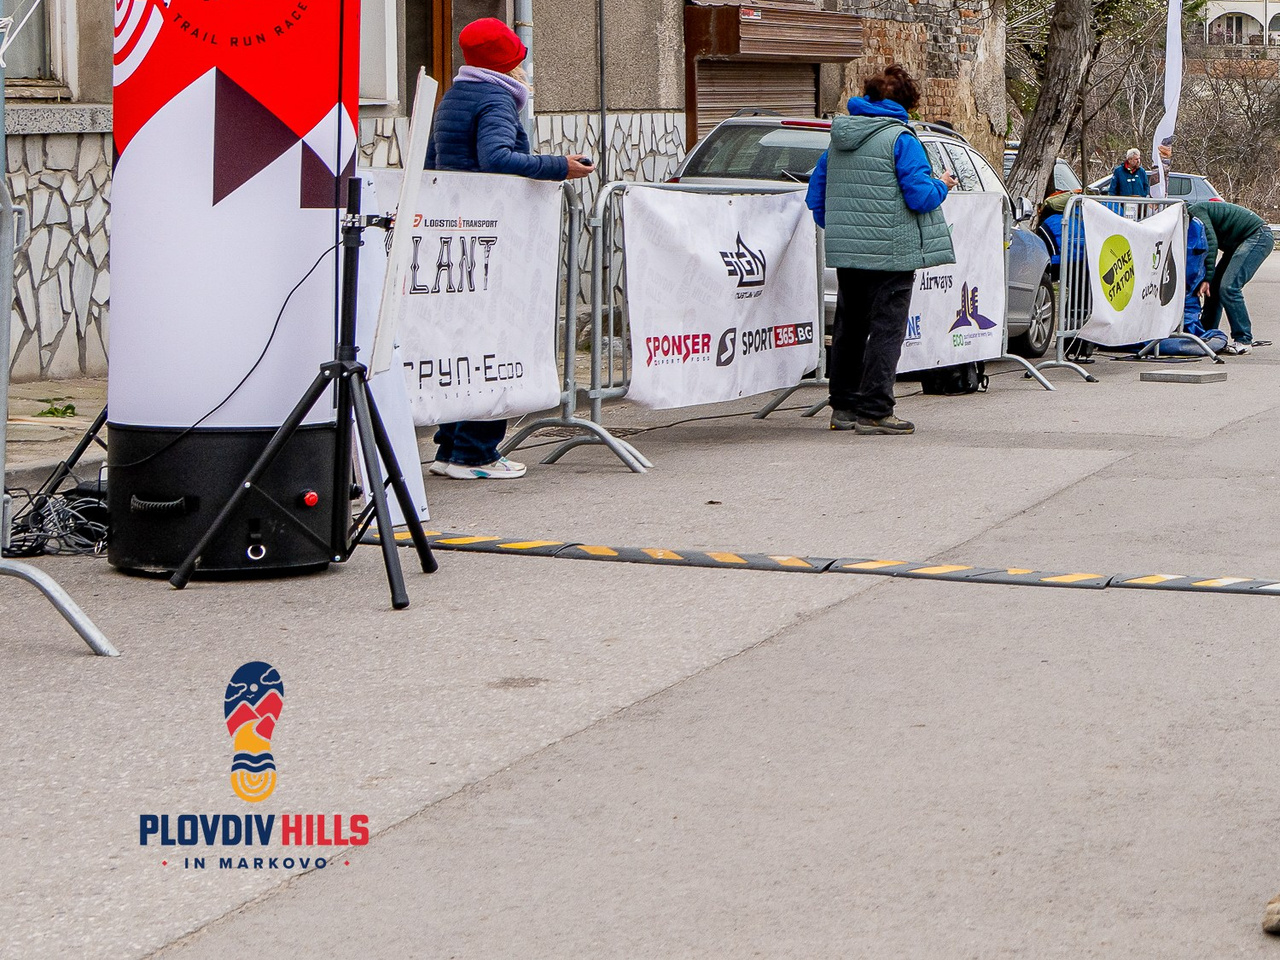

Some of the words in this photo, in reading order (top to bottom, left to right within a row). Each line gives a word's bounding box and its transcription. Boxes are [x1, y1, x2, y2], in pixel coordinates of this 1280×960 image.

[172, 12, 219, 46] TRAIL
[230, 33, 267, 48] RUN
[273, 1, 309, 37] RACE
[462, 220, 499, 228] TRANSPORT
[410, 236, 499, 295] LANT
[1112, 249, 1133, 275] POKE
[920, 271, 953, 293] Airways
[1108, 265, 1135, 302] STATION
[646, 333, 712, 367] SPONSER
